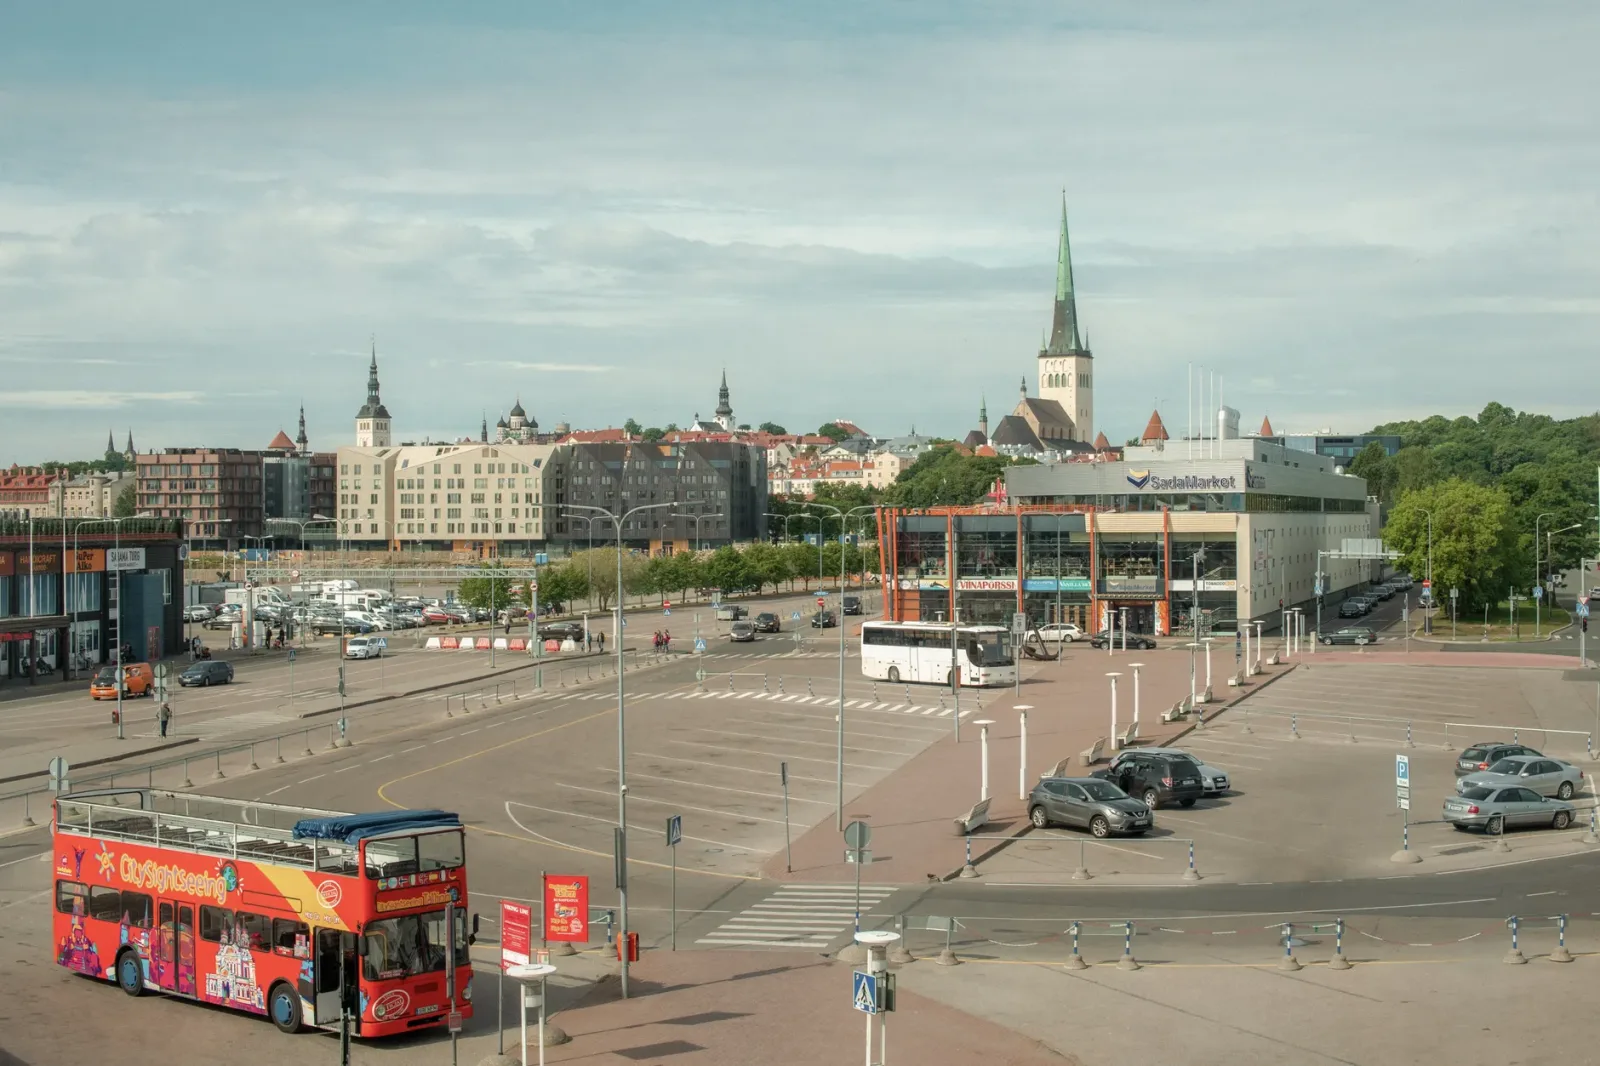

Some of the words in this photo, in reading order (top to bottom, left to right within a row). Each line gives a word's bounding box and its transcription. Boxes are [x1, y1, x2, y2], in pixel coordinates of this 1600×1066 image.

[1150, 475, 1236, 490] SadaMarket
[76, 561, 92, 570] Alko
[1400, 762, 1406, 777] P
